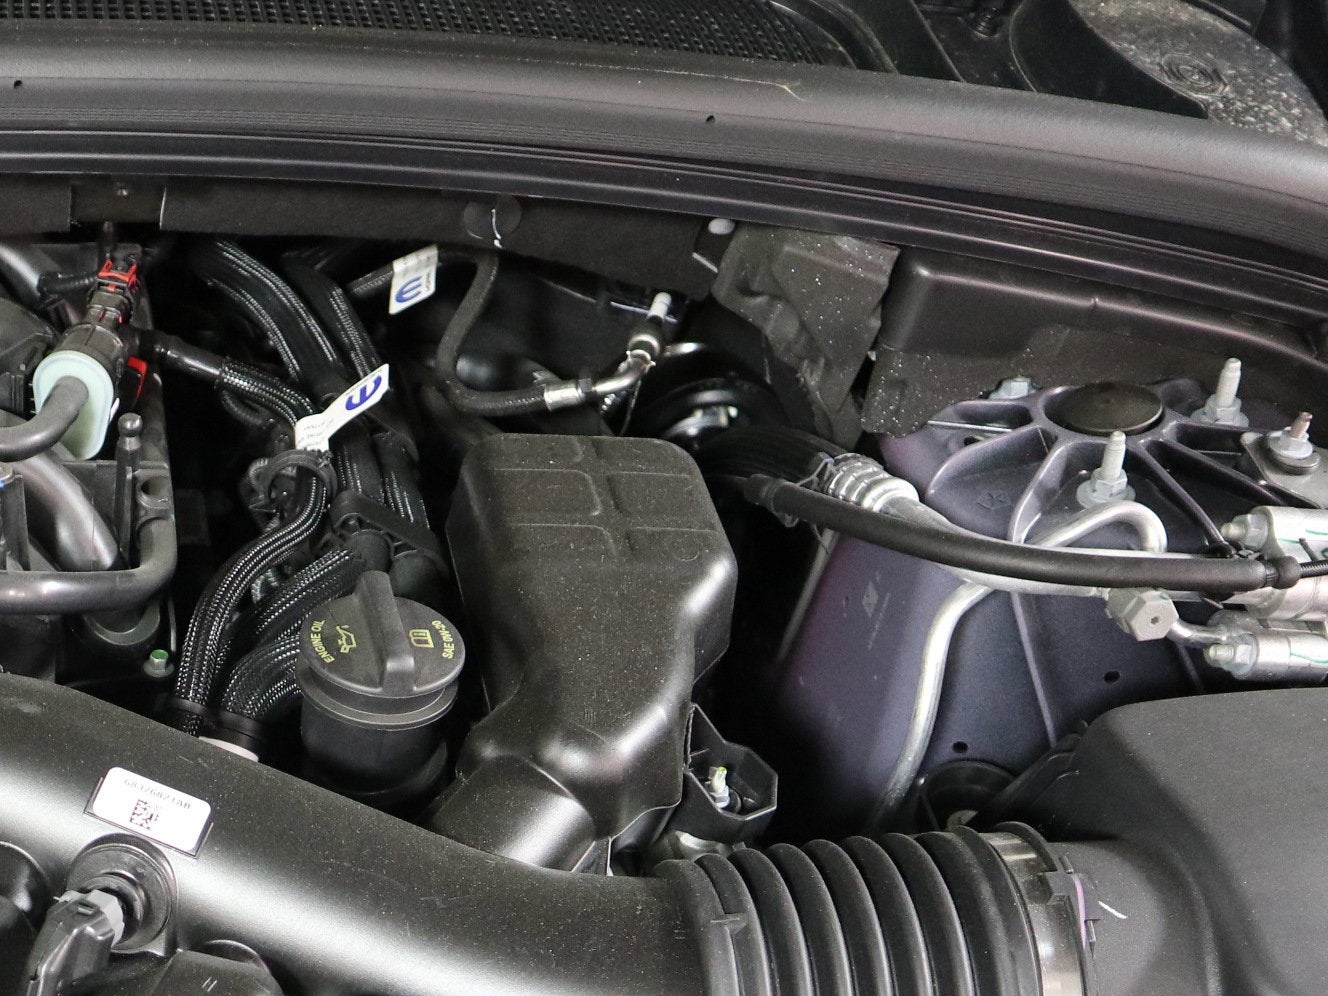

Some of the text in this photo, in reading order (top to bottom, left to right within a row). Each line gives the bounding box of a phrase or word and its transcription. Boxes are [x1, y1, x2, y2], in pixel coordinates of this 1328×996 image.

[310, 620, 335, 663] ENGINE OIL
[442, 642, 455, 659] SAE
